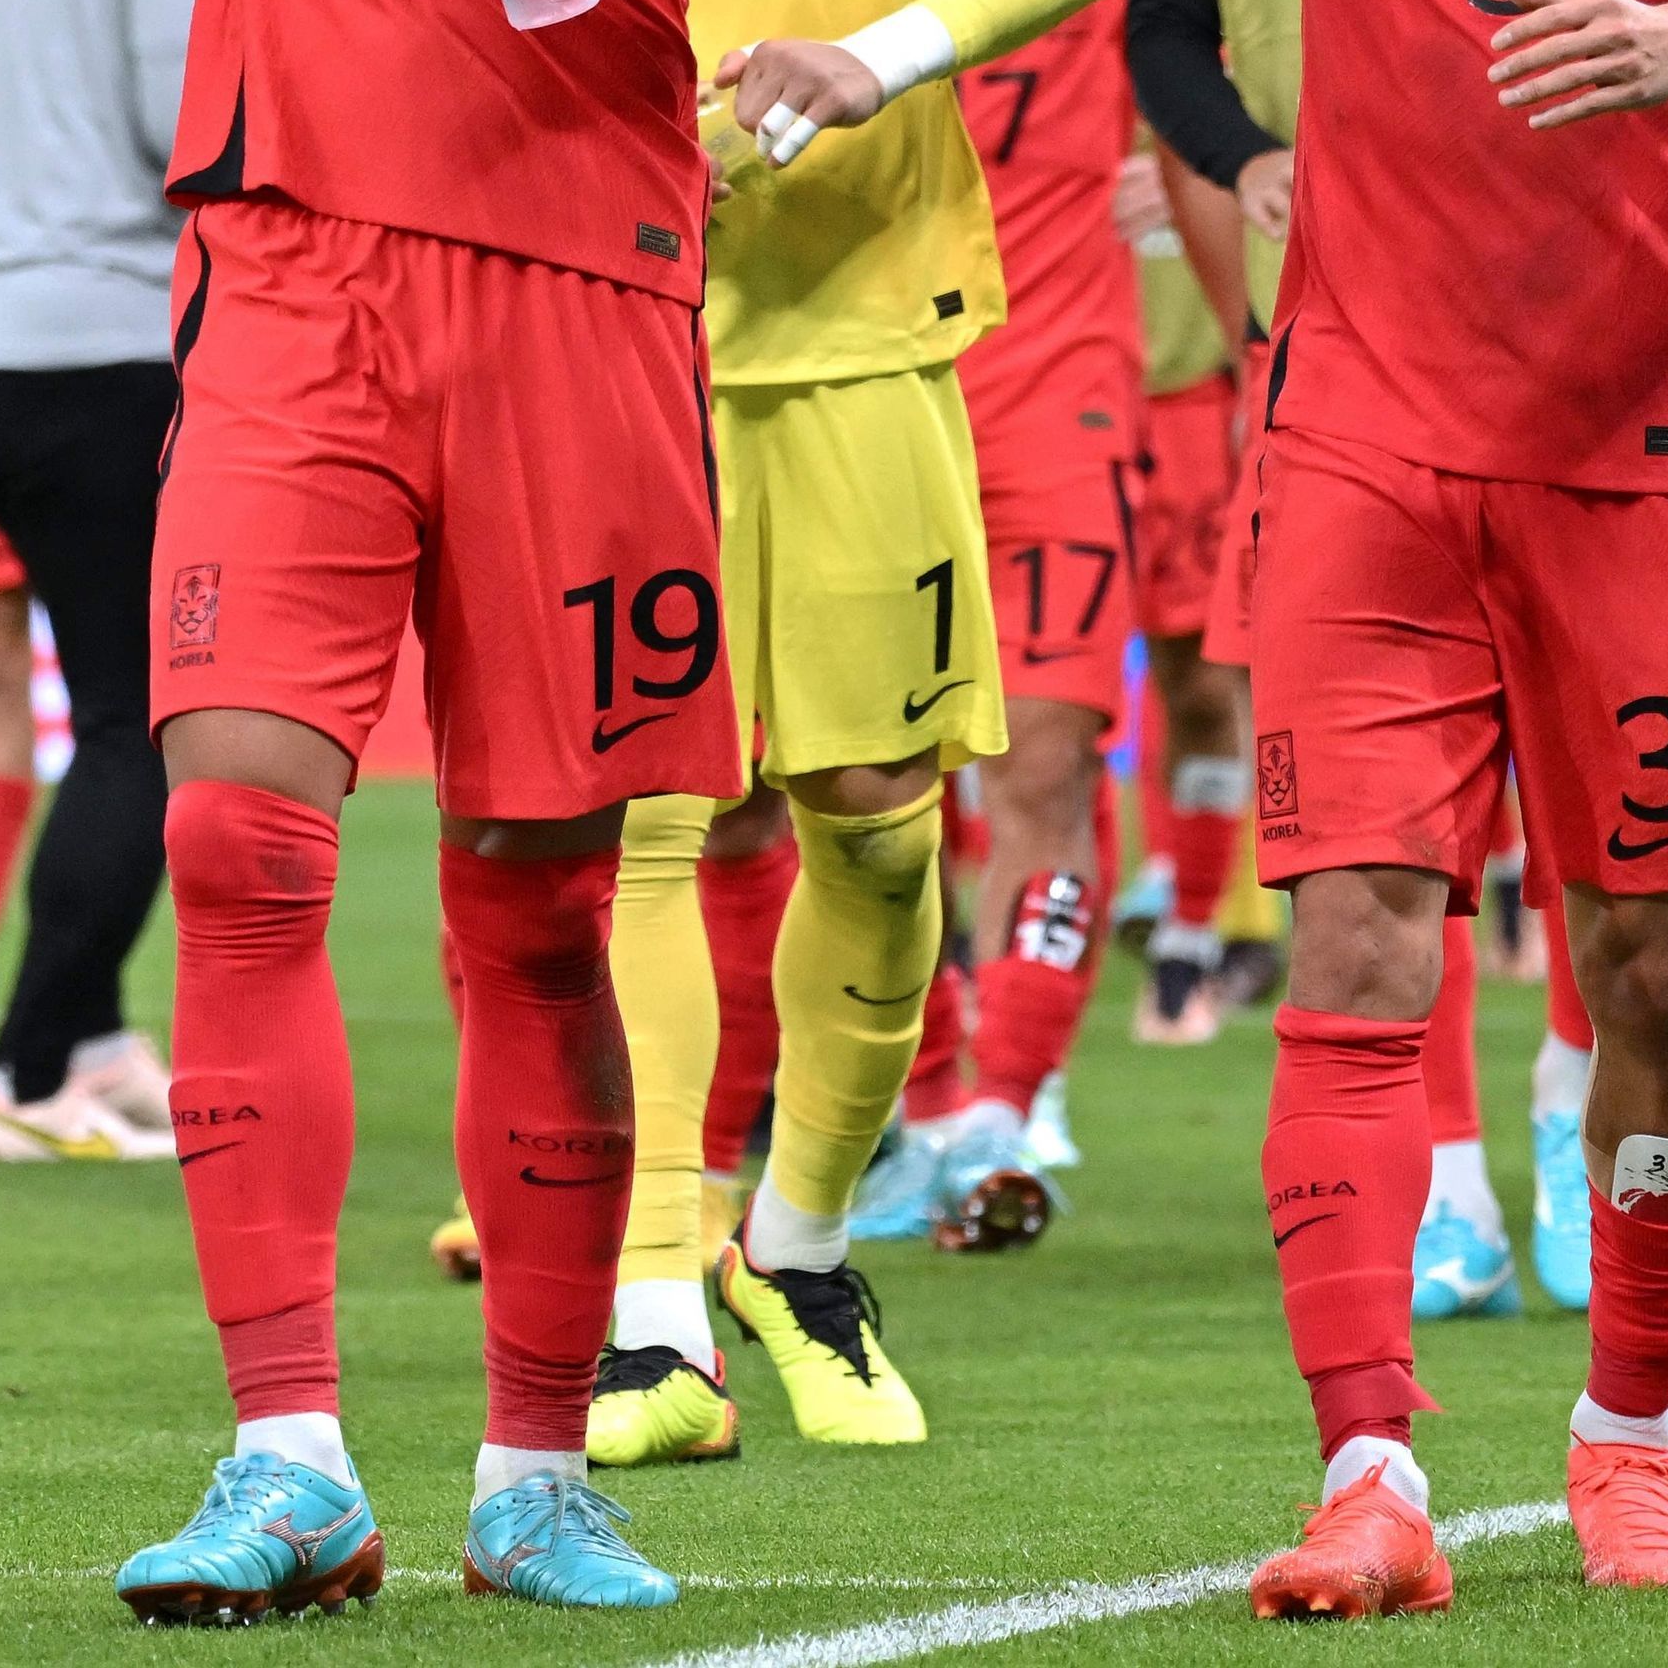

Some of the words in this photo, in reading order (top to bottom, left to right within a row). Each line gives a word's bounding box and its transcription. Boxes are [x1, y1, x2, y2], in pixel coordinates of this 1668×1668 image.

[952, 69, 1037, 165] 7
[914, 557, 953, 675] 1
[1010, 542, 1119, 638] 17
[562, 569, 720, 712] 19
[1262, 823, 1303, 843] KOREA
[1268, 1180, 1357, 1215] OREA
